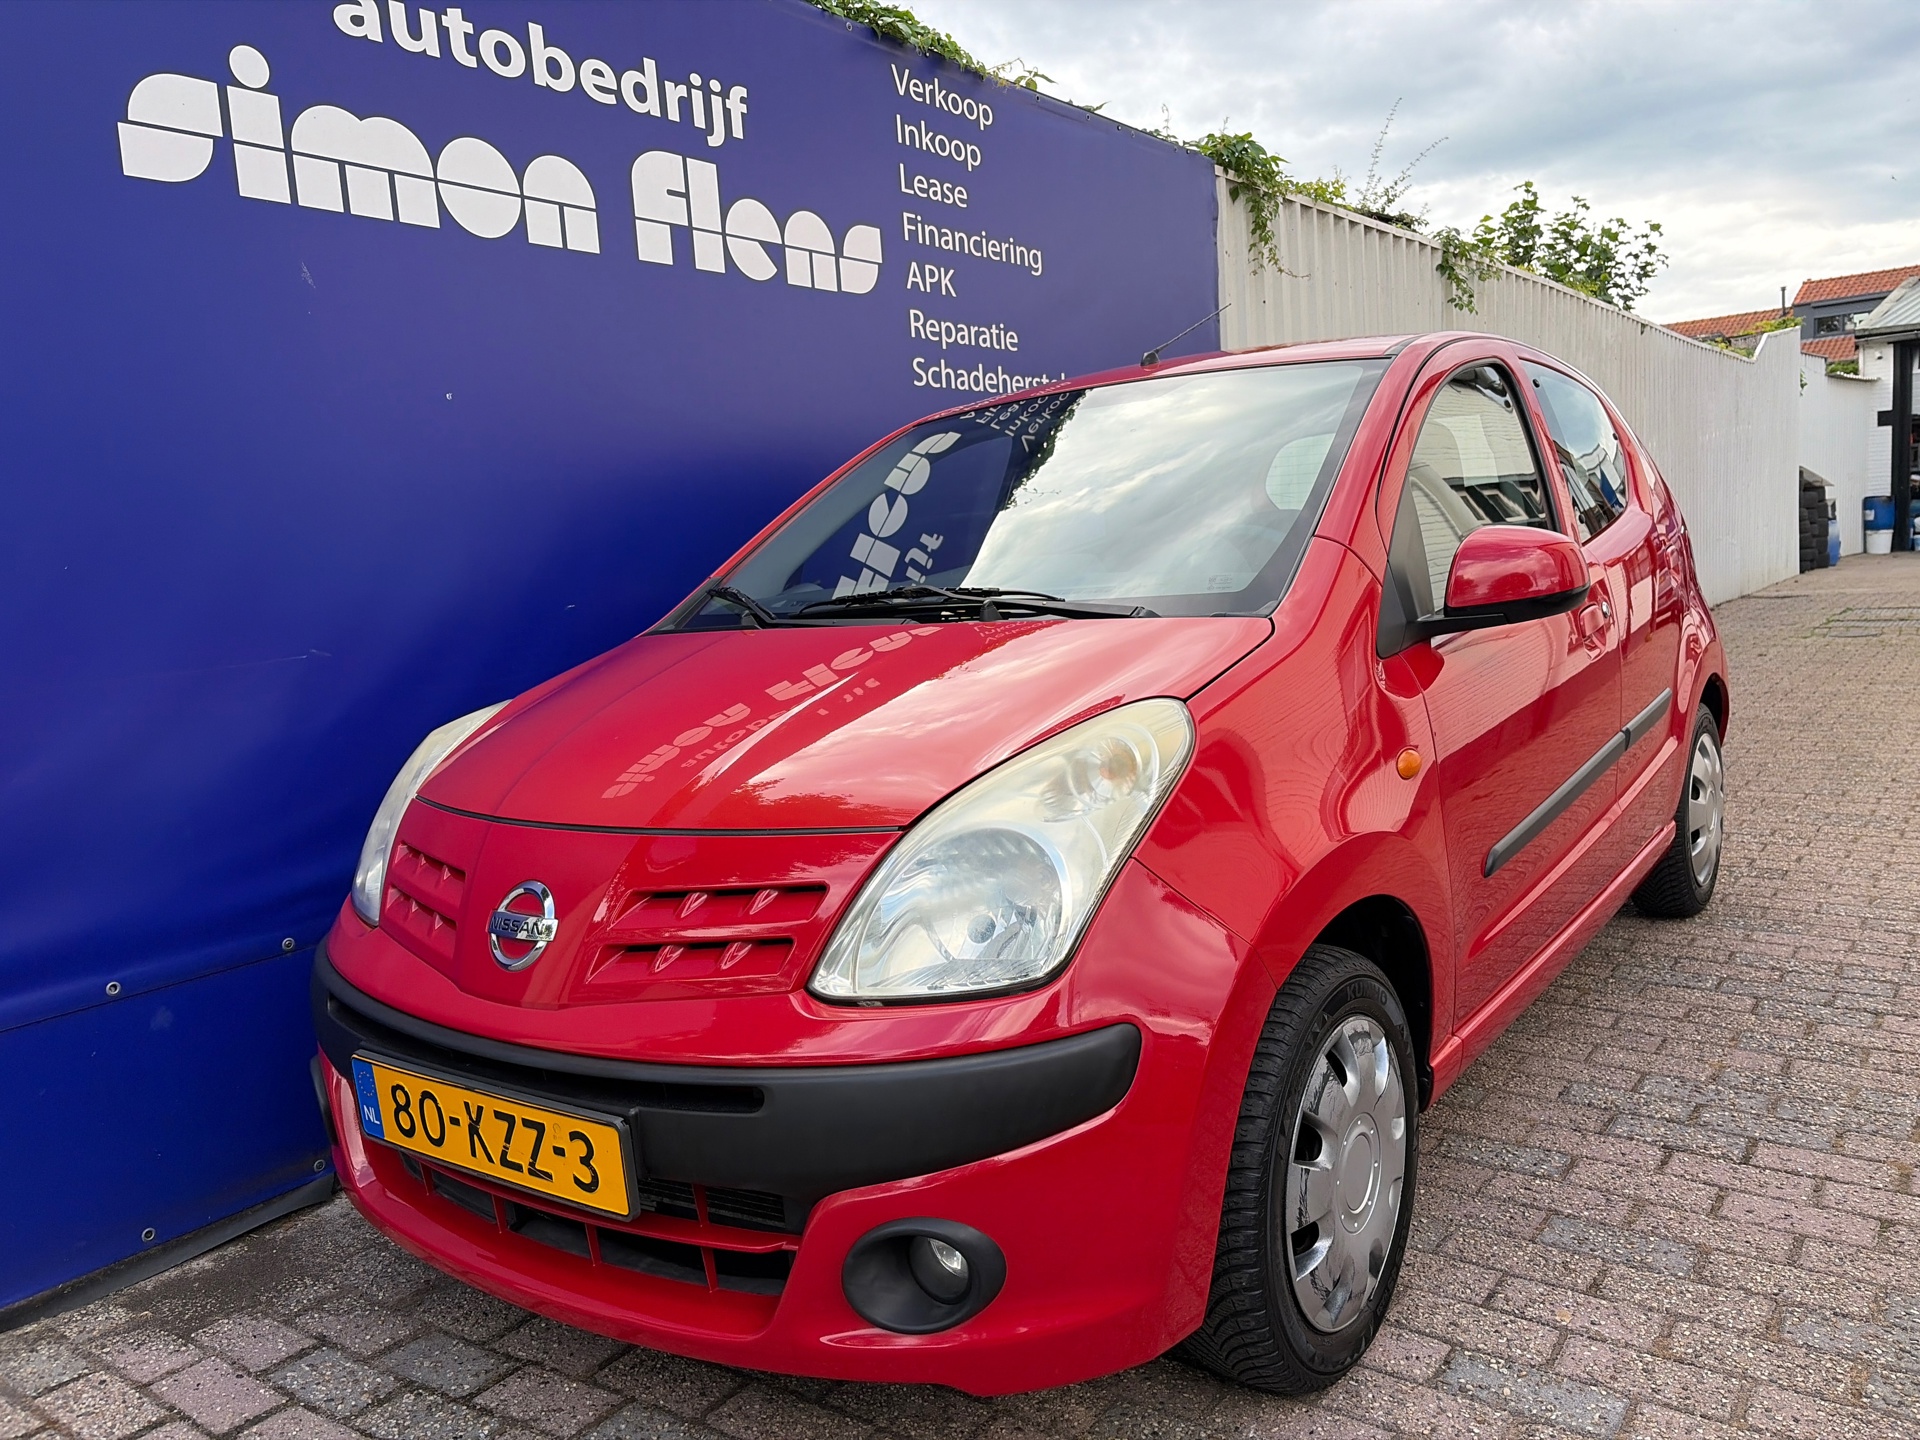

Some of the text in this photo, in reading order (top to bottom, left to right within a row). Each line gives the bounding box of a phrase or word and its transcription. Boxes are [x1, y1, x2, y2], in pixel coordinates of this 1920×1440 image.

[333, 0, 748, 147] autobedrijf
[891, 64, 993, 131] Verkoop
[117, 45, 883, 295] simon flens
[896, 114, 982, 172] Inkoop
[900, 163, 968, 208] Lease
[903, 212, 1043, 276] Financiering
[907, 262, 957, 298] APK
[910, 309, 1019, 352] Reparatie
[490, 916, 545, 936] NISSAN
[363, 1104, 381, 1126] NL
[390, 1083, 600, 1194] 80-KZZ-3
